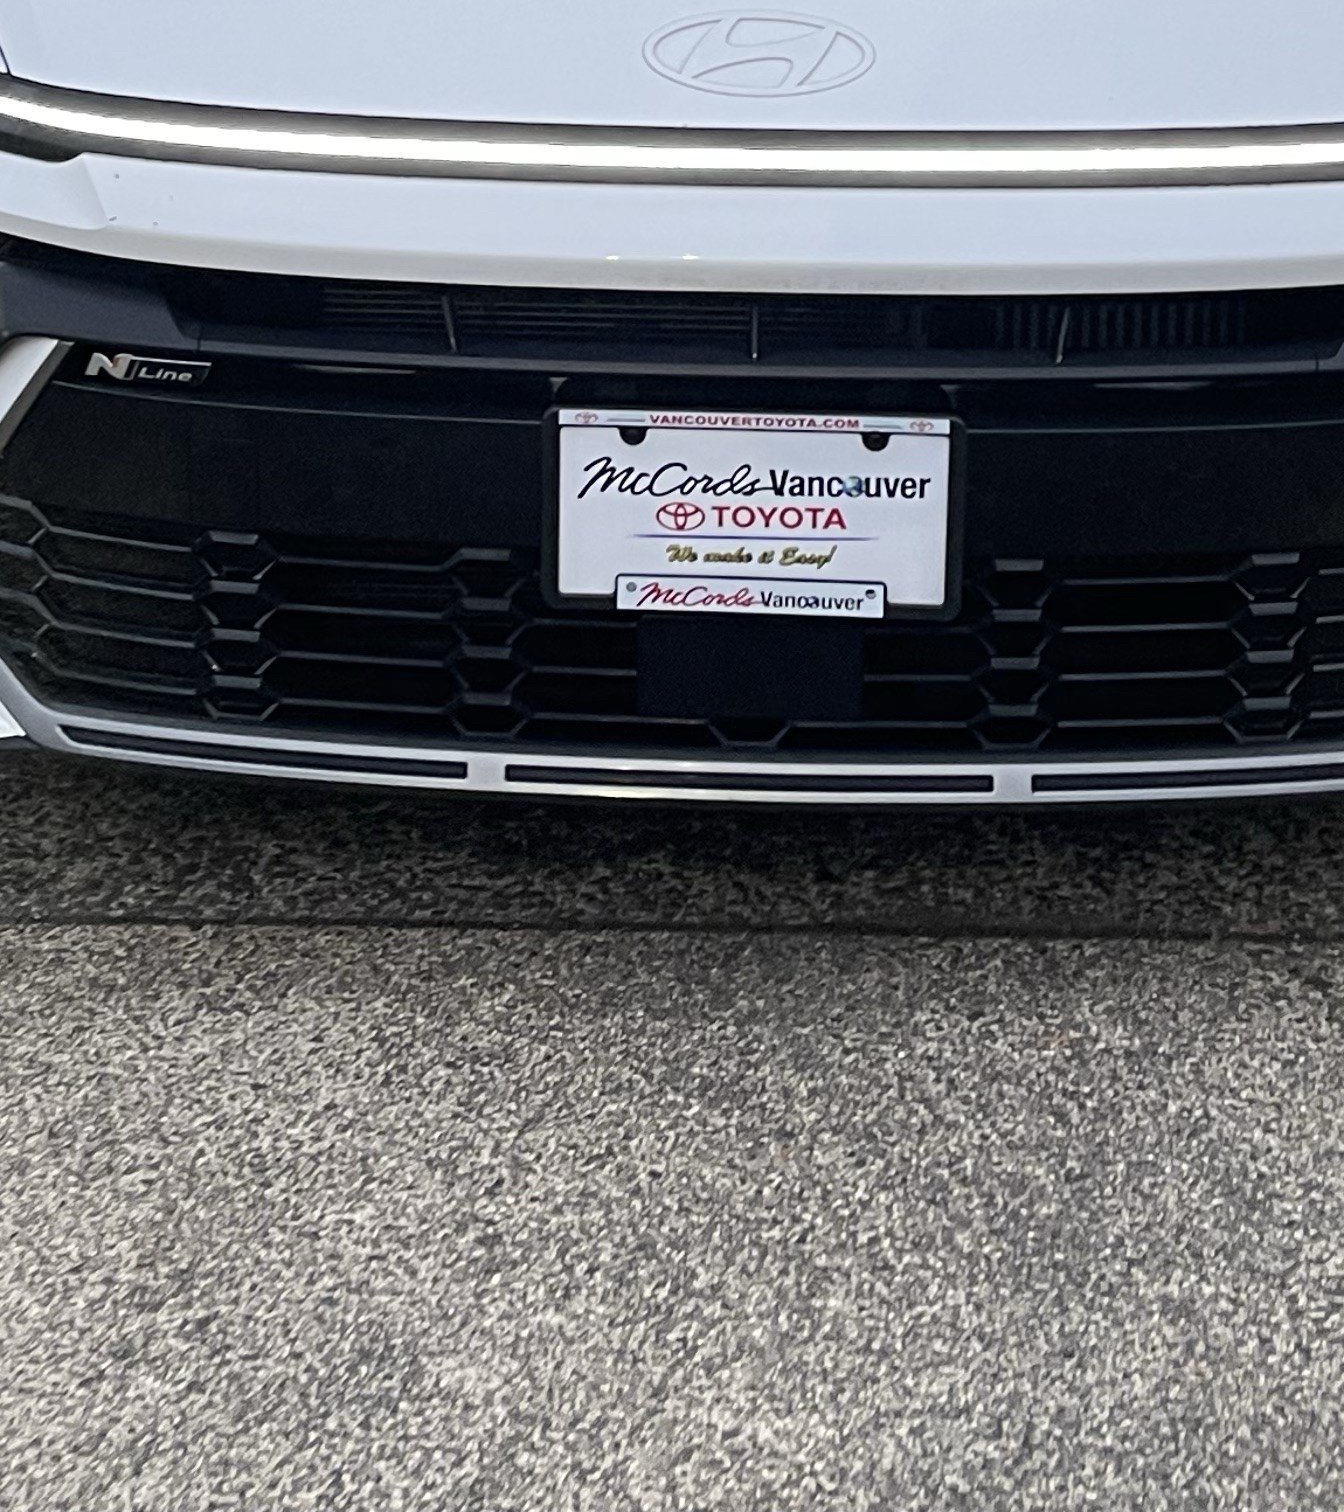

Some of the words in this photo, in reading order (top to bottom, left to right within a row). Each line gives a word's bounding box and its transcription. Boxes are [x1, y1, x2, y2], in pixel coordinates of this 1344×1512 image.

[138, 366, 193, 383] Line
[648, 413, 861, 430] VANCOUVERTOYOTA.COM
[711, 505, 847, 531] TOYOTA
[666, 544, 698, 563] We
[703, 546, 753, 563] make
[757, 549, 775, 564] it
[778, 544, 838, 570] Easy!
